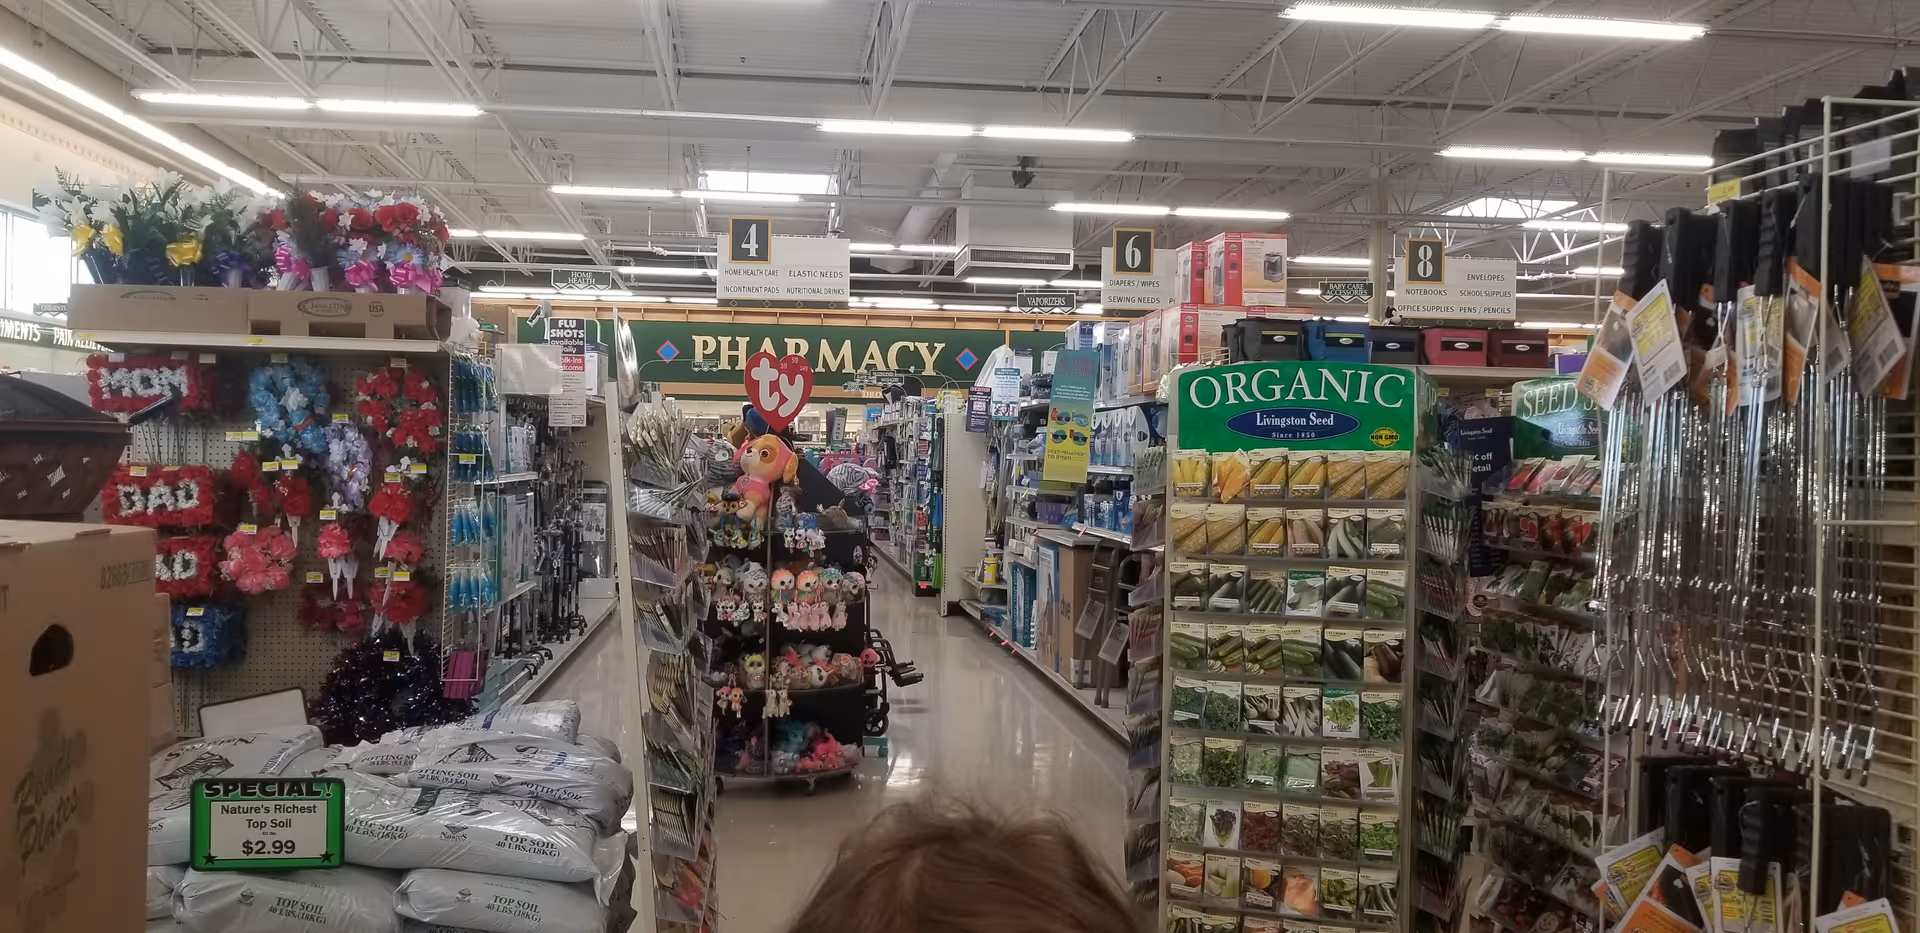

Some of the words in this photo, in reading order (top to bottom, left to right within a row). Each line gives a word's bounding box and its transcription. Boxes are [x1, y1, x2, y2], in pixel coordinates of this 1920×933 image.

[740, 223, 759, 258] 4
[1125, 234, 1142, 269] 6
[1418, 244, 1433, 278] 8
[571, 271, 593, 279] HOME
[724, 268, 742, 277] HOME
[742, 268, 763, 277] HEALTH
[764, 268, 779, 277] CARE
[788, 270, 817, 279] ELASTIC
[818, 270, 844, 279] NEEDS
[1467, 273, 1505, 282] ENVELOPES
[568, 276, 595, 285] HEALTH
[1109, 279, 1134, 288] DIAPERS
[1140, 279, 1160, 288] WIPES
[723, 285, 761, 294] INCONTINENT
[763, 286, 780, 295] PADS
[786, 286, 821, 295] NUTRITIONAL
[822, 287, 845, 296] DRINKS
[1329, 283, 1345, 291] BABY
[1347, 282, 1365, 291] CARE
[1326, 288, 1368, 297] ACCESSORIES
[1405, 288, 1448, 297] NOTEBOOKS
[1459, 289, 1481, 298] SCHOOL
[1482, 289, 1512, 299] SUPPLIES
[1027, 296, 1066, 307] VAPORIZERS
[1107, 295, 1135, 304] SEWING
[1136, 295, 1161, 304] NEEDS
[369, 304, 384, 313] USA
[1397, 304, 1422, 313] OFFICE
[1422, 304, 1455, 314] SUPPLIES
[1459, 305, 1476, 314] PENS
[1484, 305, 1511, 315] PENCILS
[558, 319, 577, 328] FLU
[550, 329, 584, 338] SHOTS
[550, 338, 584, 346] available
[692, 335, 945, 376] PHARMACY
[560, 363, 583, 371] elcome
[97, 366, 188, 400] MOM
[751, 357, 804, 418] ty
[1189, 368, 1406, 409] ORGANIC
[1522, 381, 1579, 420] SEED
[1256, 412, 1305, 427] Livingston
[1308, 411, 1334, 427] Seed
[1271, 431, 1293, 440] Since
[1295, 431, 1316, 440] 1850
[1481, 452, 1493, 461] off
[1472, 463, 1492, 472] etail
[117, 478, 200, 518] DAD
[456, 771, 481, 781] SOIL
[204, 782, 334, 799] SPECIAL!
[221, 804, 271, 815] Nature's
[274, 804, 317, 814] Richest
[246, 819, 267, 830] Top
[270, 818, 292, 828] Soil
[352, 818, 378, 829] TOP
[378, 823, 407, 833] SOIL
[495, 841, 507, 849] 40
[503, 833, 528, 846] TOP
[529, 838, 558, 850] SOIL
[242, 839, 296, 856] $2.99
[268, 905, 278, 914] 40
[276, 896, 299, 909] TOP
[300, 902, 325, 916] SOIL
[486, 904, 495, 912] 40
[493, 895, 515, 907] TOP
[515, 900, 541, 914] SOIL
